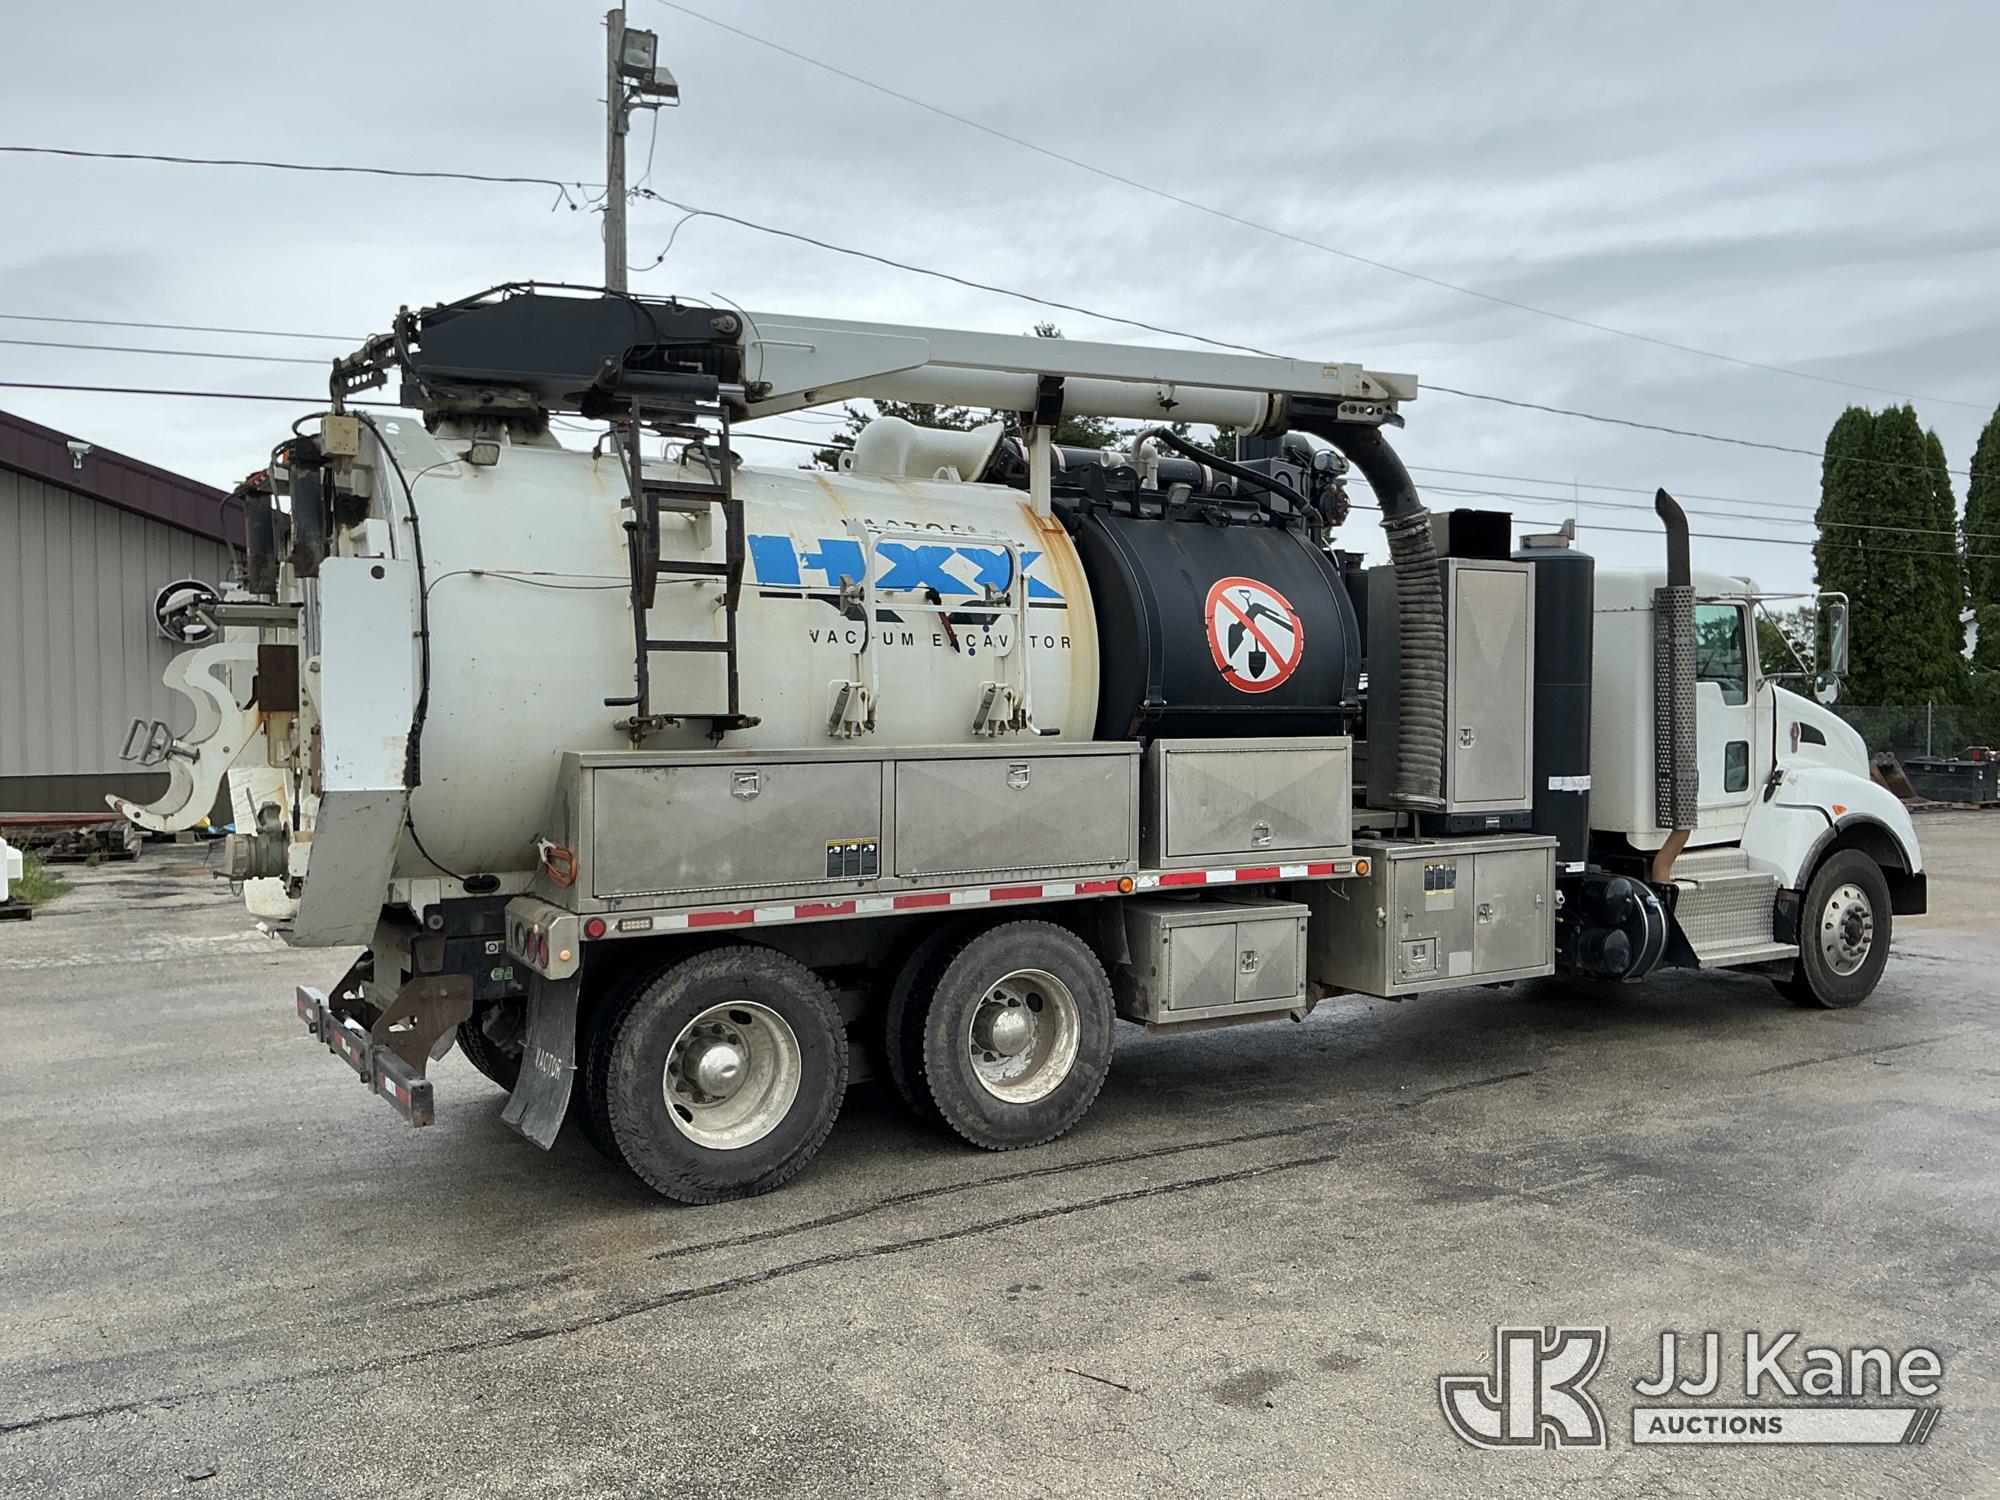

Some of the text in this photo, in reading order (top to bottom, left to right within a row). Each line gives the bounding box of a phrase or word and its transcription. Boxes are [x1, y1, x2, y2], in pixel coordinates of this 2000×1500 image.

[810, 629, 1072, 650] VACUM ECAVTOR
[535, 1046, 562, 1080] VACTOR
